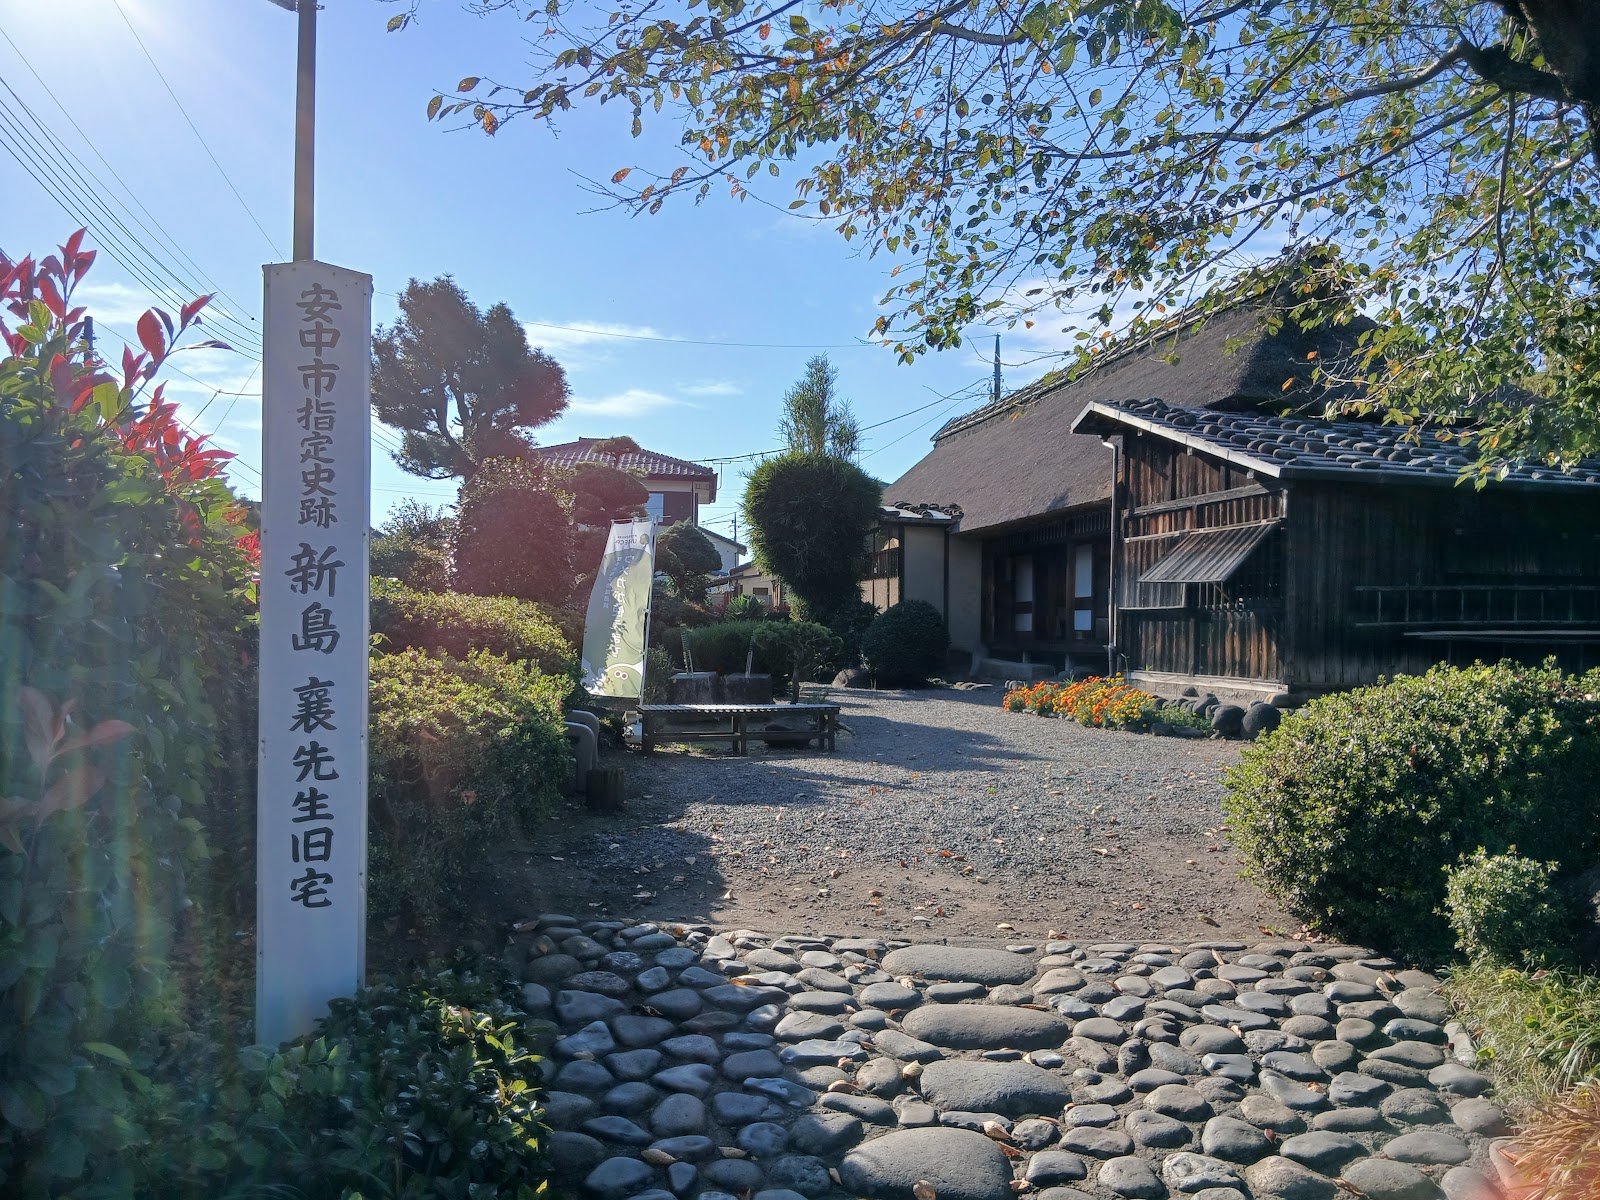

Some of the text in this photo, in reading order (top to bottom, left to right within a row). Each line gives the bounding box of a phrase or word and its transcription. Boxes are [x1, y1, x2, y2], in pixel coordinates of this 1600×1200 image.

[284, 282, 346, 909] 安中市指定史跡 新島 襄先生旧宅
